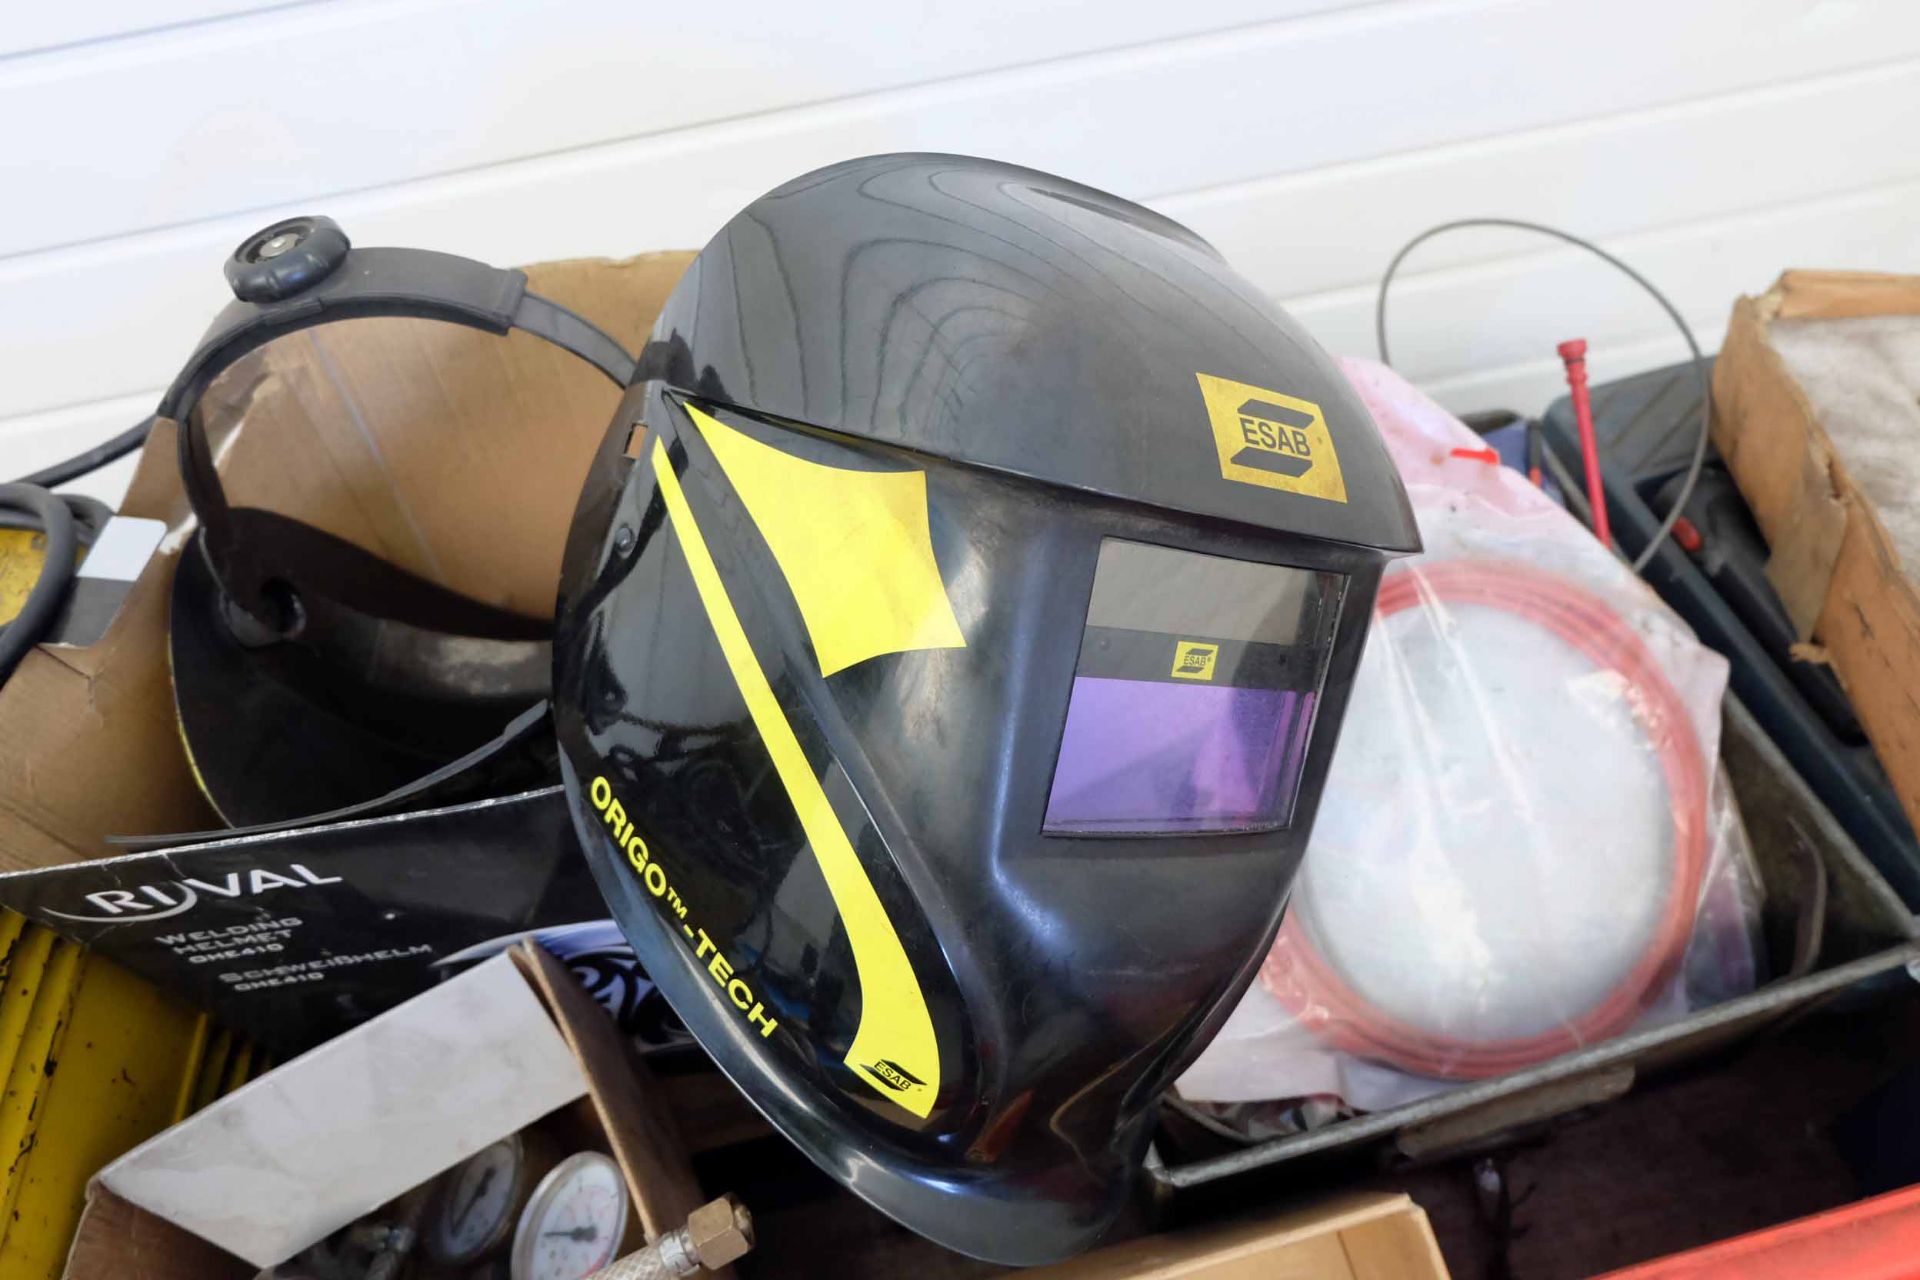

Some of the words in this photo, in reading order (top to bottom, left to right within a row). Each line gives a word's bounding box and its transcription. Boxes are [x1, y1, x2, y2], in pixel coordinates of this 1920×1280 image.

[1239, 417, 1311, 456] ESAB
[85, 863, 343, 914] RIVAL
[154, 917, 303, 945] WELDING
[172, 929, 292, 955] HELMET
[874, 1061, 912, 1090] ESAB
